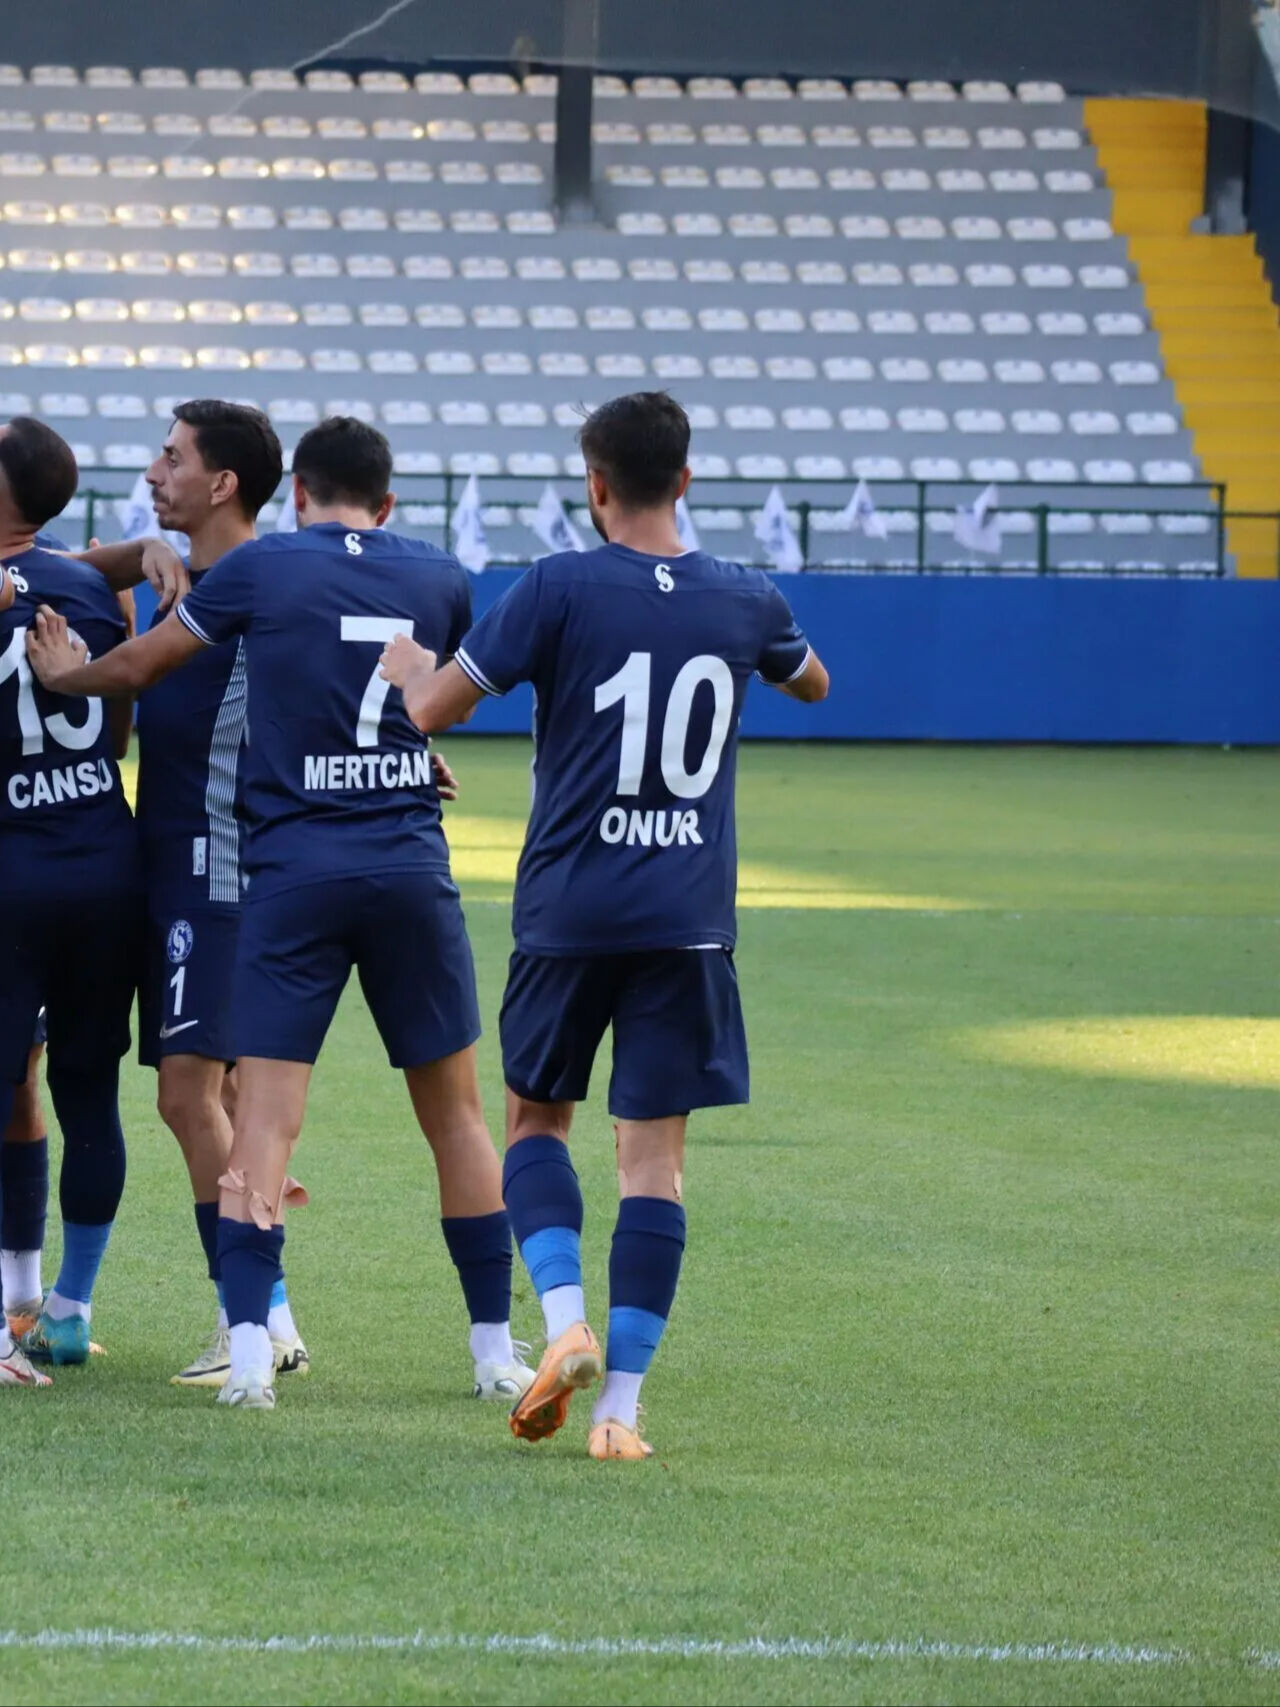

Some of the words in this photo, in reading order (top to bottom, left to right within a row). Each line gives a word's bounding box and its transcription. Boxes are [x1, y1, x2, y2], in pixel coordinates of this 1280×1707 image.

[340, 615, 415, 748] 7
[594, 651, 735, 799] 10
[303, 749, 431, 790] MERTCAN
[599, 807, 705, 847] ONUR
[170, 966, 187, 1016] 1
